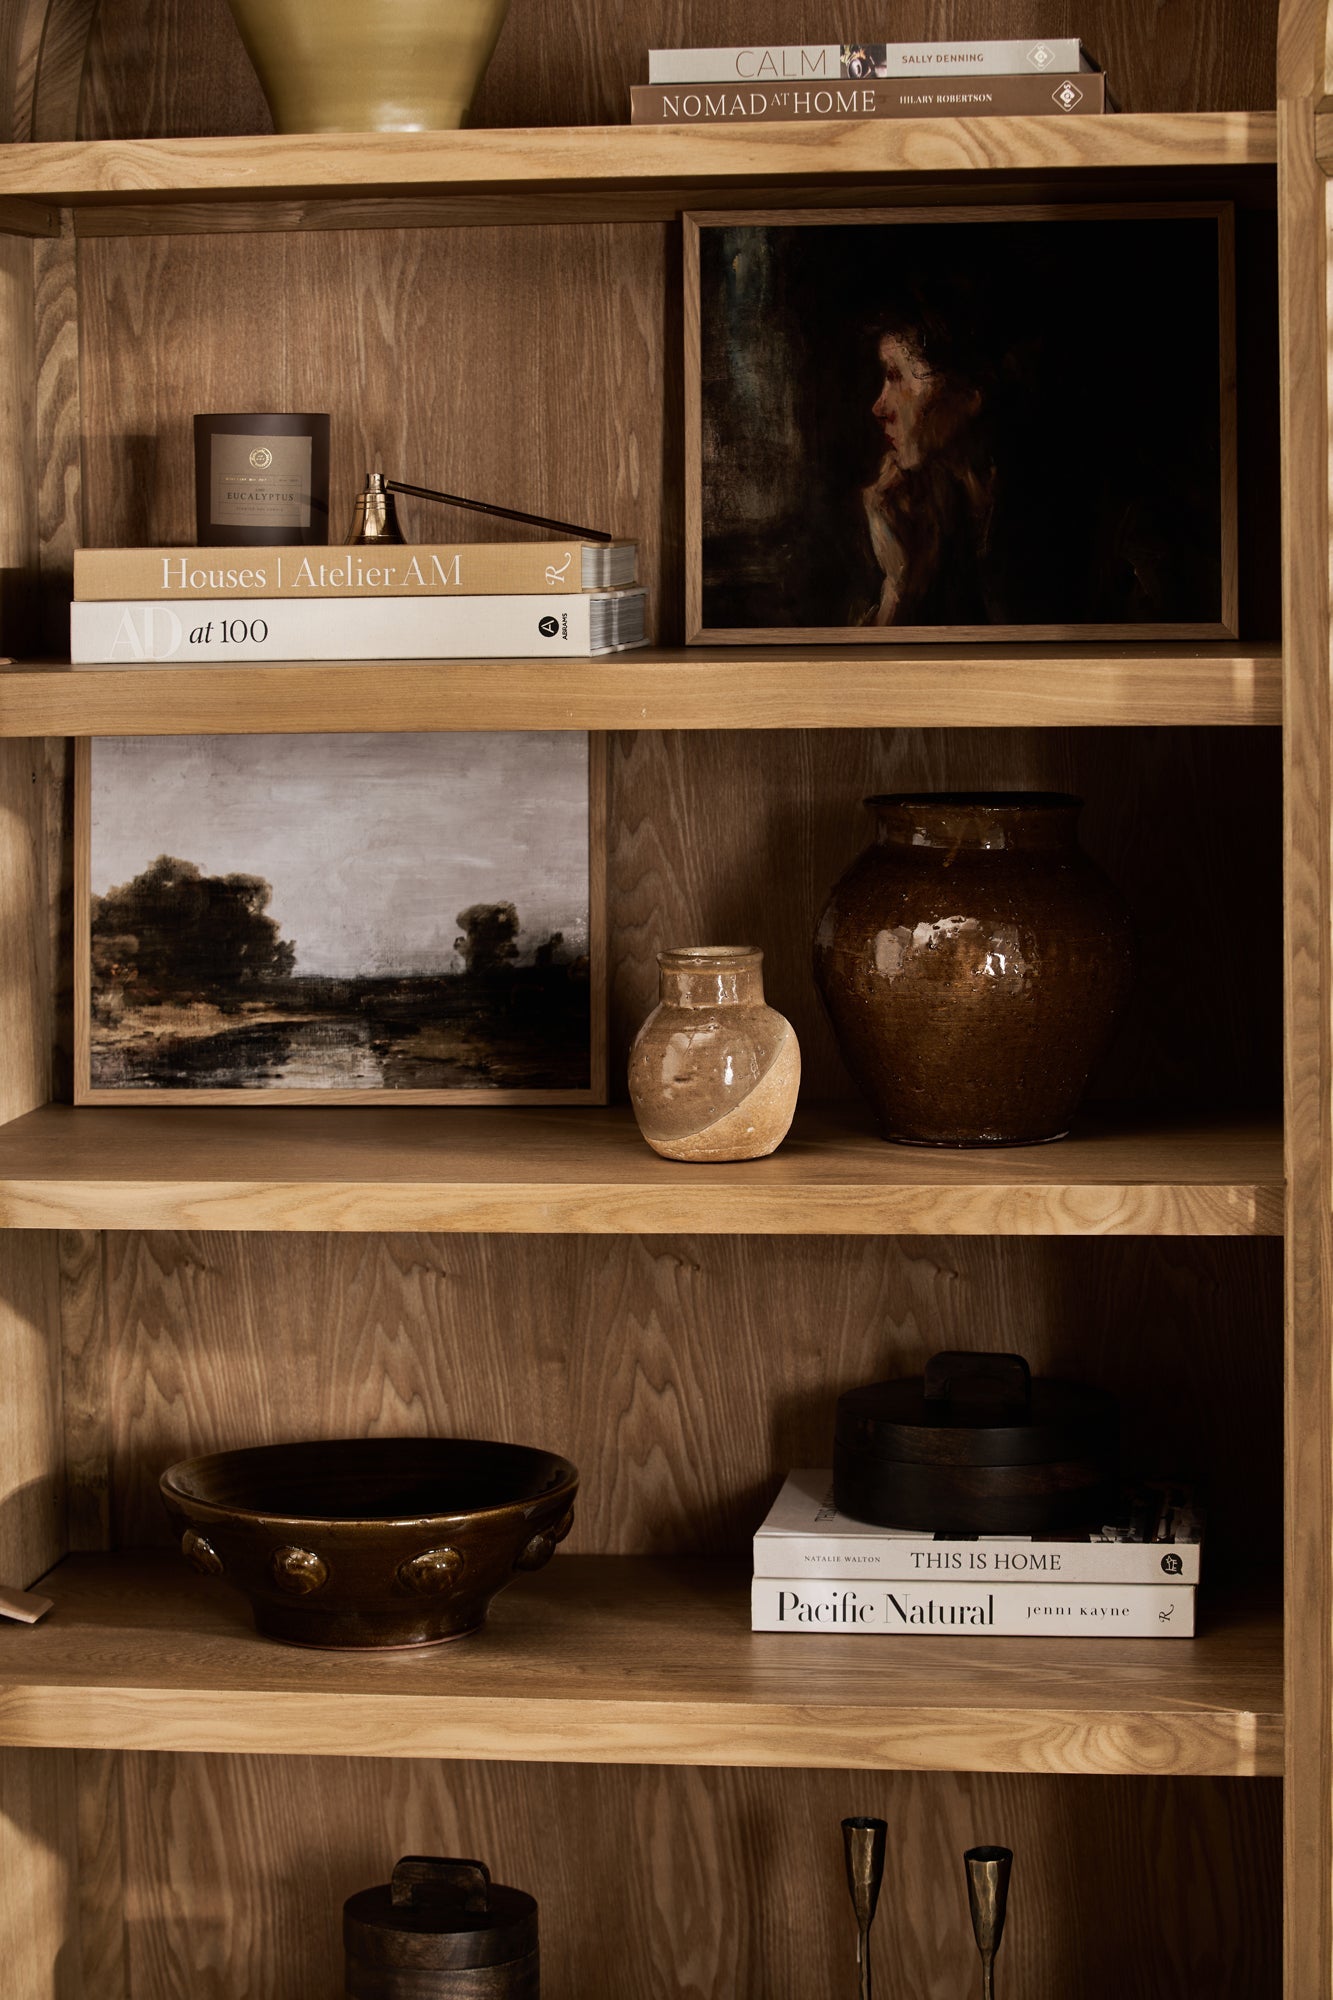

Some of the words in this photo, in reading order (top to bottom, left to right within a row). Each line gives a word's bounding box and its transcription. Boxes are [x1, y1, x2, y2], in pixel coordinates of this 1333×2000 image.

[735, 49, 827, 78] CALM
[901, 55, 933, 64] SALLY
[935, 53, 984, 63] DENNING
[662, 93, 768, 118] NOMAD
[770, 92, 790, 106] AT
[793, 90, 876, 114] HOME
[899, 95, 934, 105] HILARY
[936, 93, 993, 104] ROBERTSON
[227, 492, 294, 501] EUCALYPTUS
[160, 557, 267, 589] Houses
[290, 555, 397, 588] Atelier
[399, 554, 463, 586] AM
[103, 606, 183, 660] AD
[189, 621, 214, 644] at
[220, 618, 268, 644] 100
[804, 1555, 841, 1564] NATALIE
[844, 1556, 881, 1564] WALTON
[910, 1552, 962, 1570] THIS
[969, 1553, 988, 1570] IS
[994, 1554, 1062, 1571] HOME
[776, 1591, 876, 1625] Pacific
[882, 1593, 995, 1626] Natural
